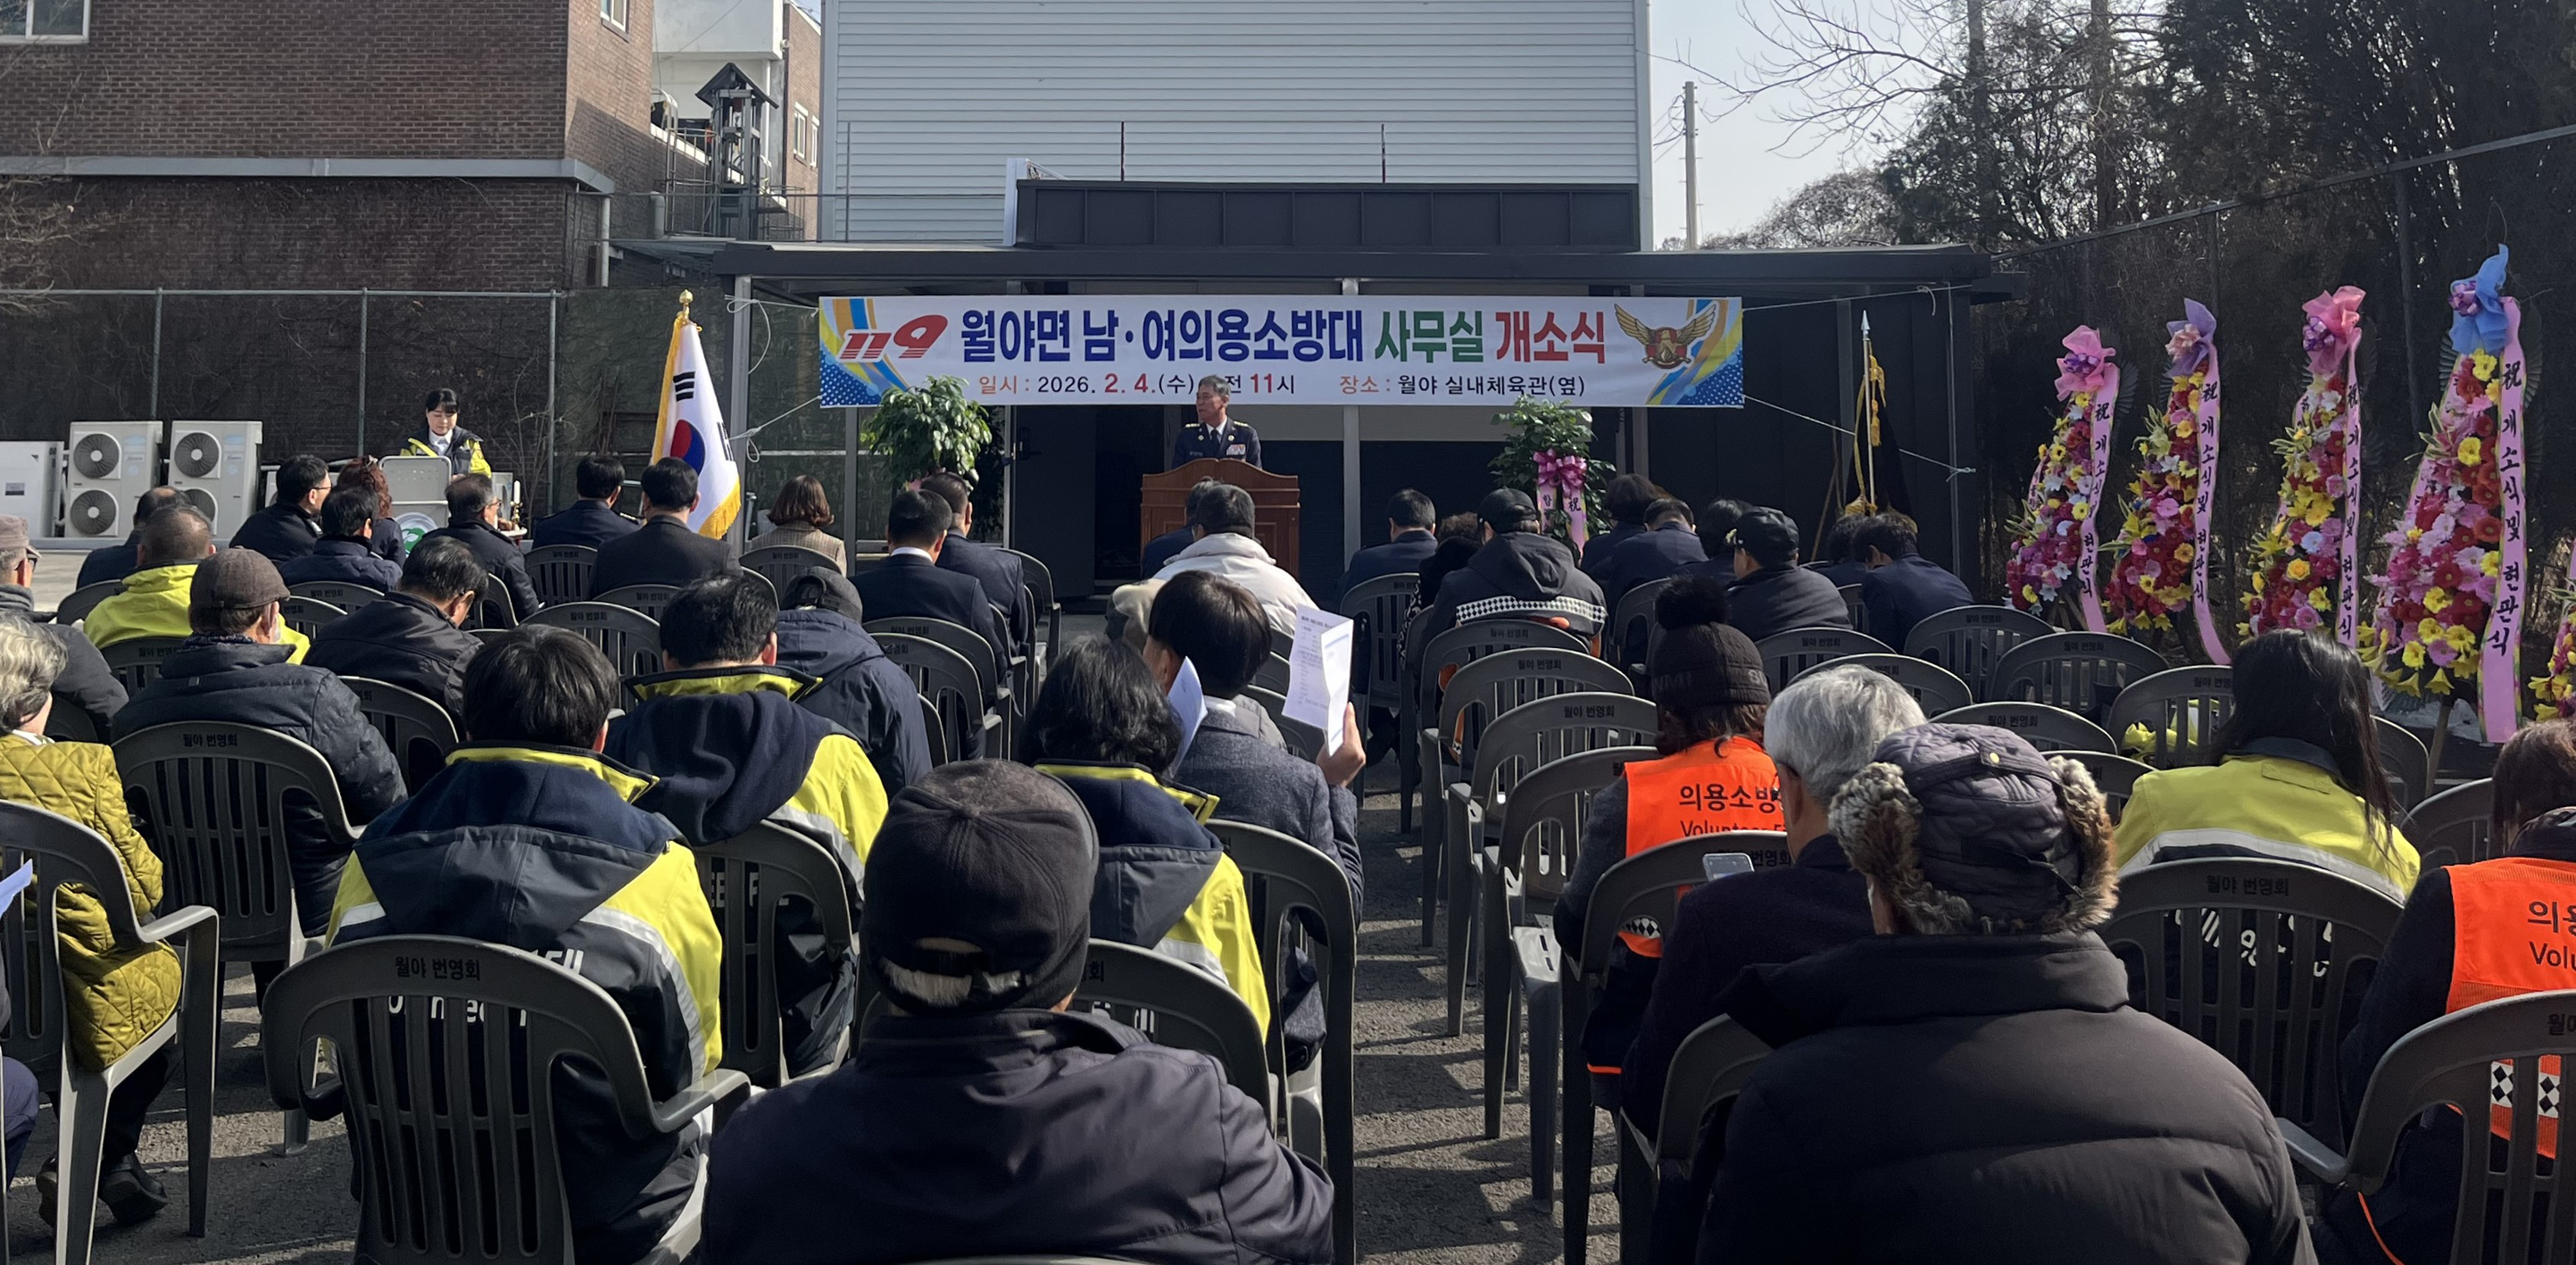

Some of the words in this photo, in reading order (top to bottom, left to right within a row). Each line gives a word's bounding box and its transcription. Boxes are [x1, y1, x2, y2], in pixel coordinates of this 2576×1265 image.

[839, 314, 949, 361] 119
[961, 309, 1070, 362] 월야면
[1375, 310, 1484, 362] 사무실
[1496, 312, 1606, 364] 개소식
[1037, 376, 1096, 395] 2026.
[1251, 373, 1295, 395] 11시
[1398, 375, 1439, 395] 월야
[2502, 361, 2522, 390] 祝
[2201, 381, 2216, 403] 祝
[2095, 403, 2110, 421] 祝
[2487, 562, 2519, 656] 현판식
[183, 733, 204, 747] 월야
[206, 733, 238, 748] 번영회
[2206, 875, 2238, 895] 월야
[2243, 877, 2289, 896] 번영회
[395, 956, 427, 978] 월야
[432, 957, 481, 981] 번영회
